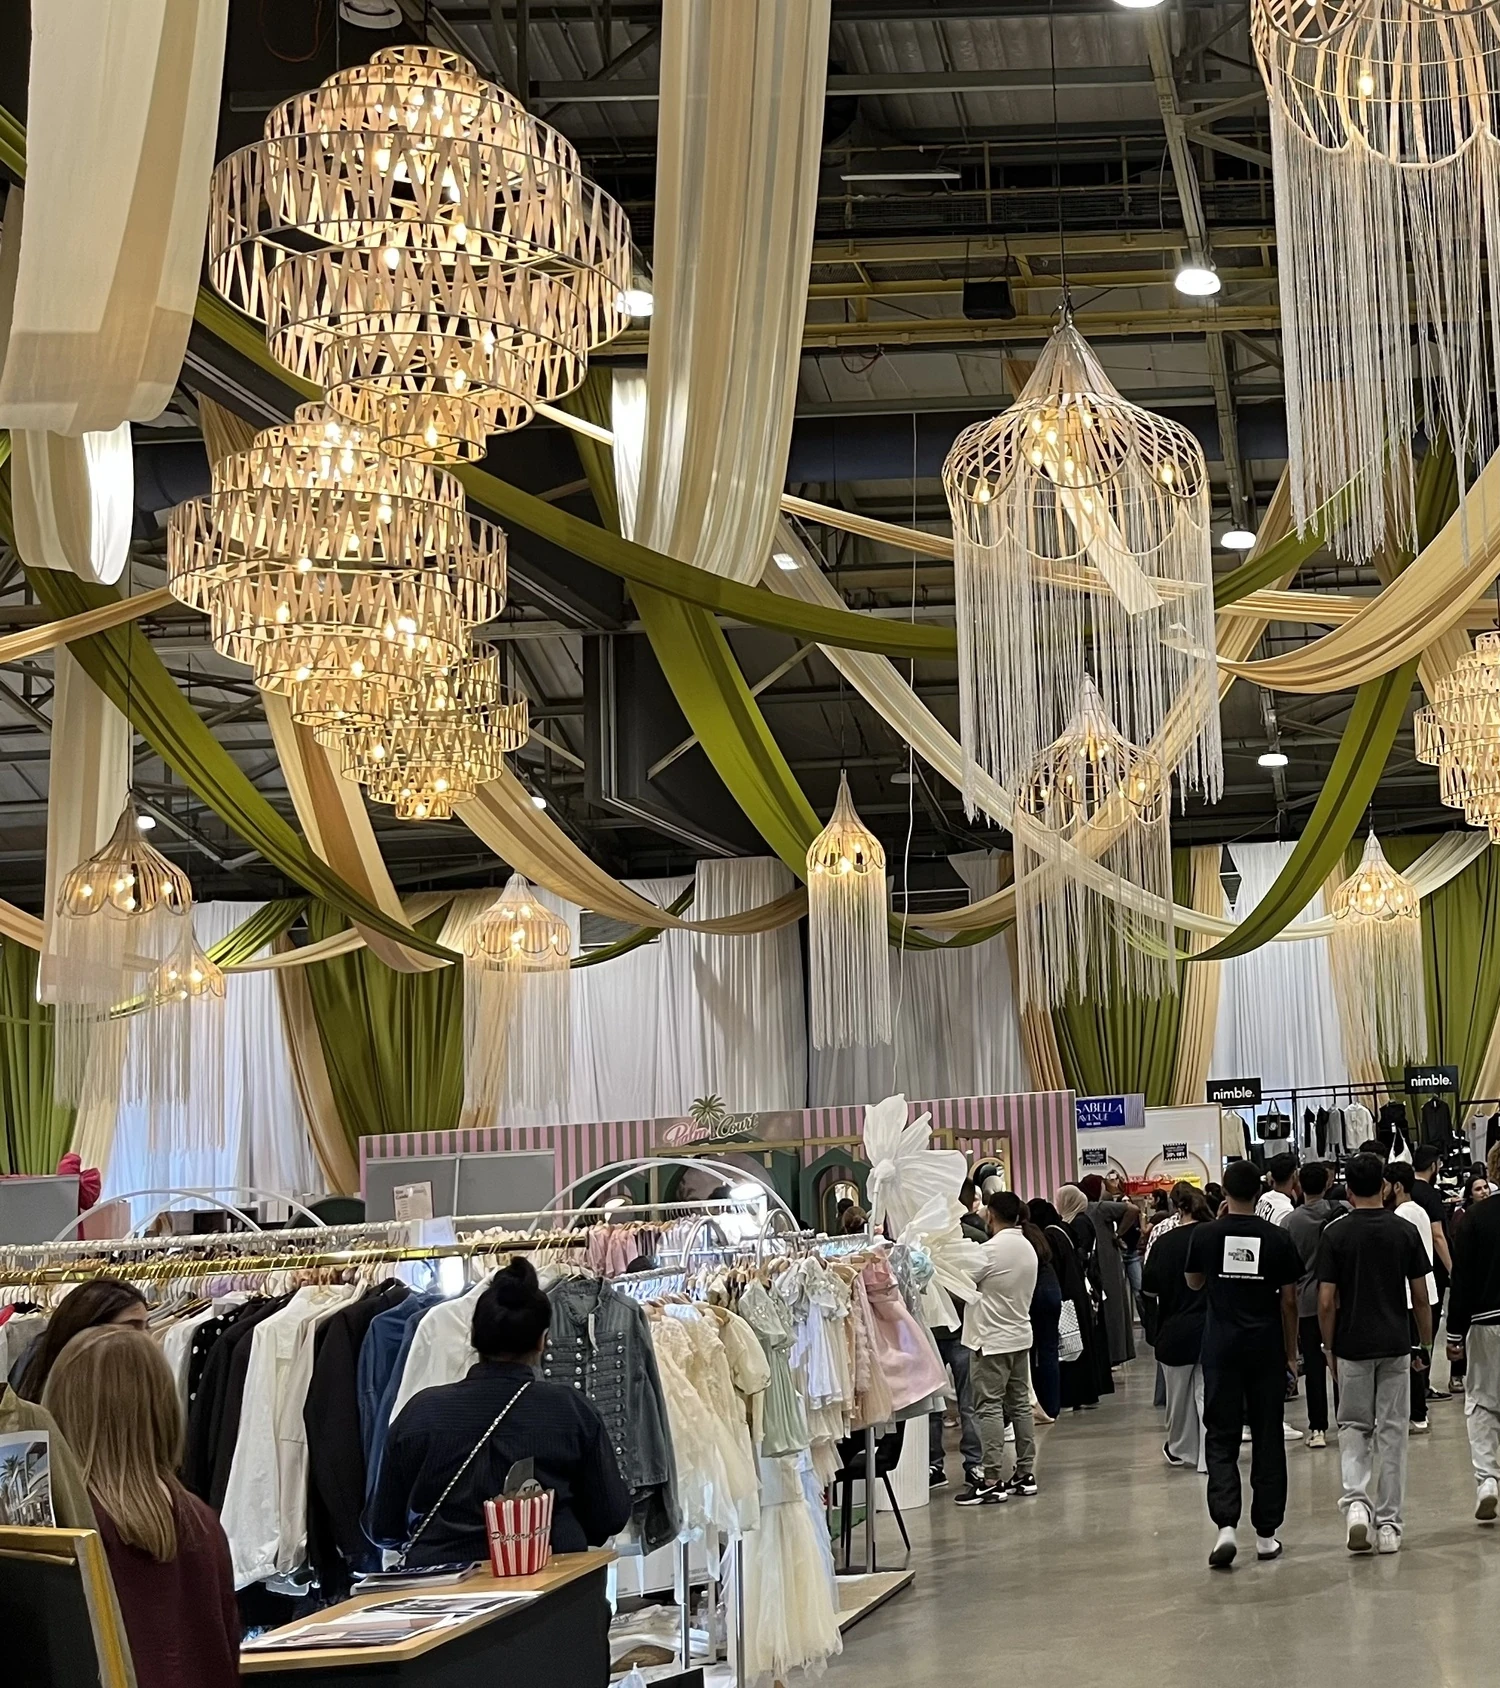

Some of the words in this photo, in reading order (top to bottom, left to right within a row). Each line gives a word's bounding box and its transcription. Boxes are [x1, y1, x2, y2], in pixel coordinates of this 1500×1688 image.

[1411, 1073, 1453, 1087] nimble.
[1213, 1088, 1255, 1101] nimble.
[1076, 1102, 1123, 1114] SABELLA
[663, 1119, 710, 1147] Palm
[717, 1113, 759, 1139] Court
